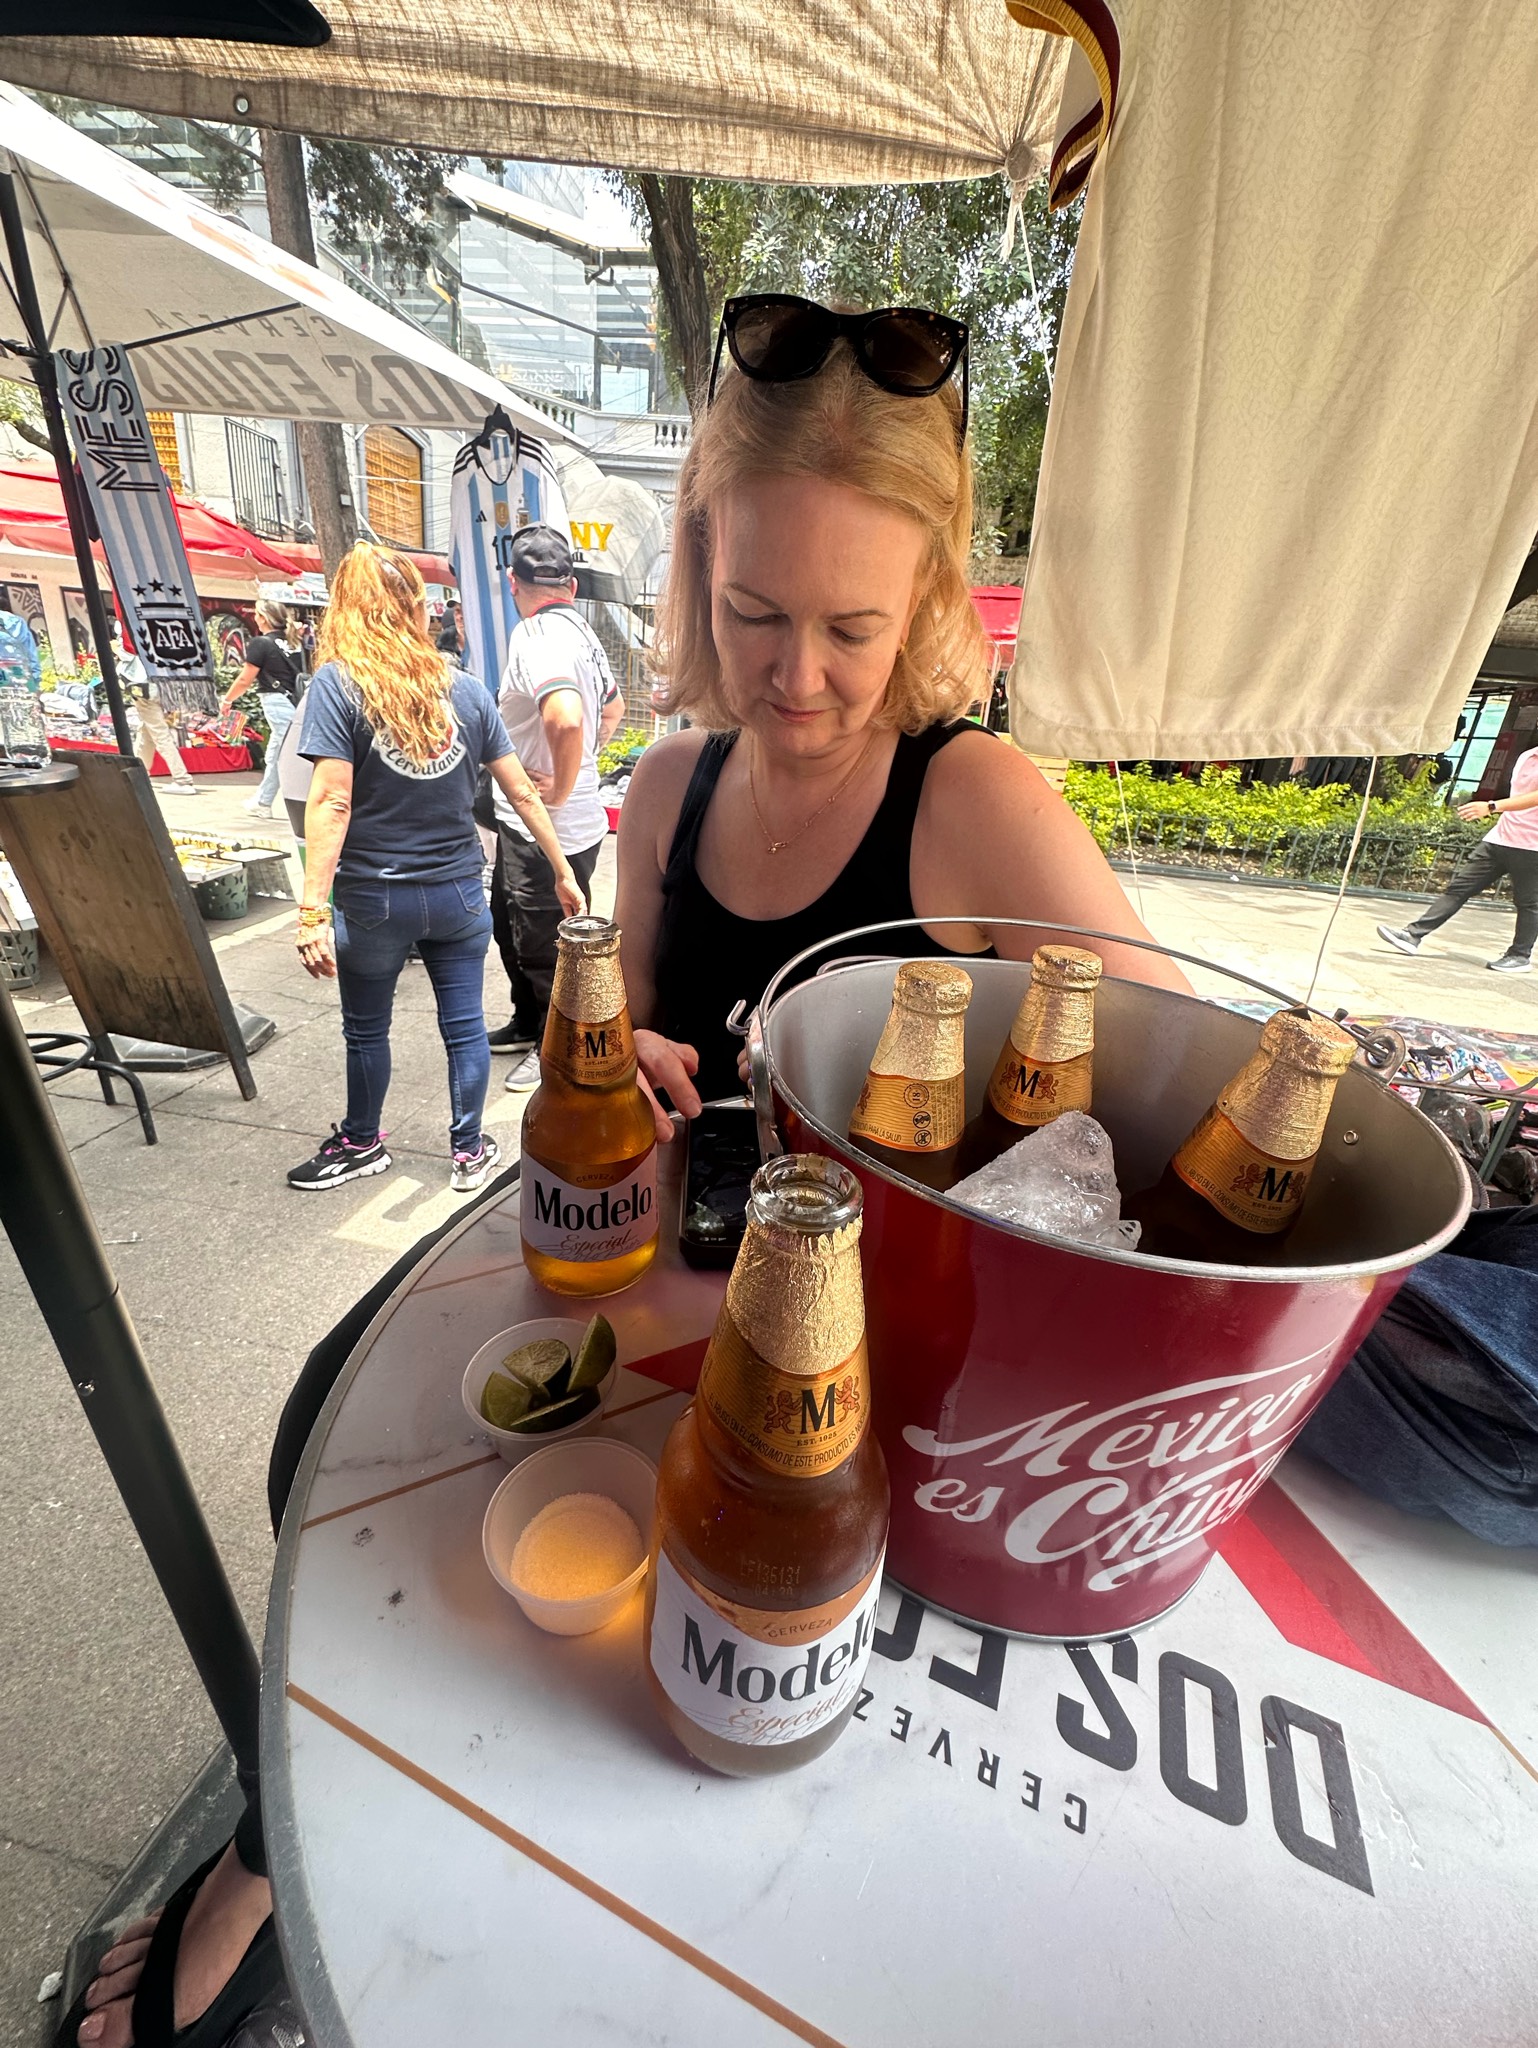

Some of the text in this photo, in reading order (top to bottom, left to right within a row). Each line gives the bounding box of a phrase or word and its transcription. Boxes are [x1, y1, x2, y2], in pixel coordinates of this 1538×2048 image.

[59, 345, 161, 493] MESS
[155, 620, 194, 650] AFA
[585, 1030, 607, 1059] M
[1013, 1064, 1042, 1098] M
[575, 1173, 615, 1184] CERVEZA
[1257, 1166, 1293, 1203] M
[534, 1178, 652, 1232] Modelo
[560, 1228, 633, 1256] Especial
[800, 1381, 837, 1435] M
[902, 1336, 1338, 1477] México
[748, 1432, 784, 1463] CONSUMO
[783, 1453, 794, 1467] DE
[794, 1454, 813, 1468] ESTE
[814, 1440, 849, 1466] PRODUCTO
[848, 1431, 857, 1446] ES
[914, 1477, 1005, 1523] es
[768, 1617, 833, 1638] CERVEZA
[681, 1599, 879, 1705] Modelo
[729, 1679, 846, 1736] Especial
[853, 1688, 1088, 1835] CERVEZ
